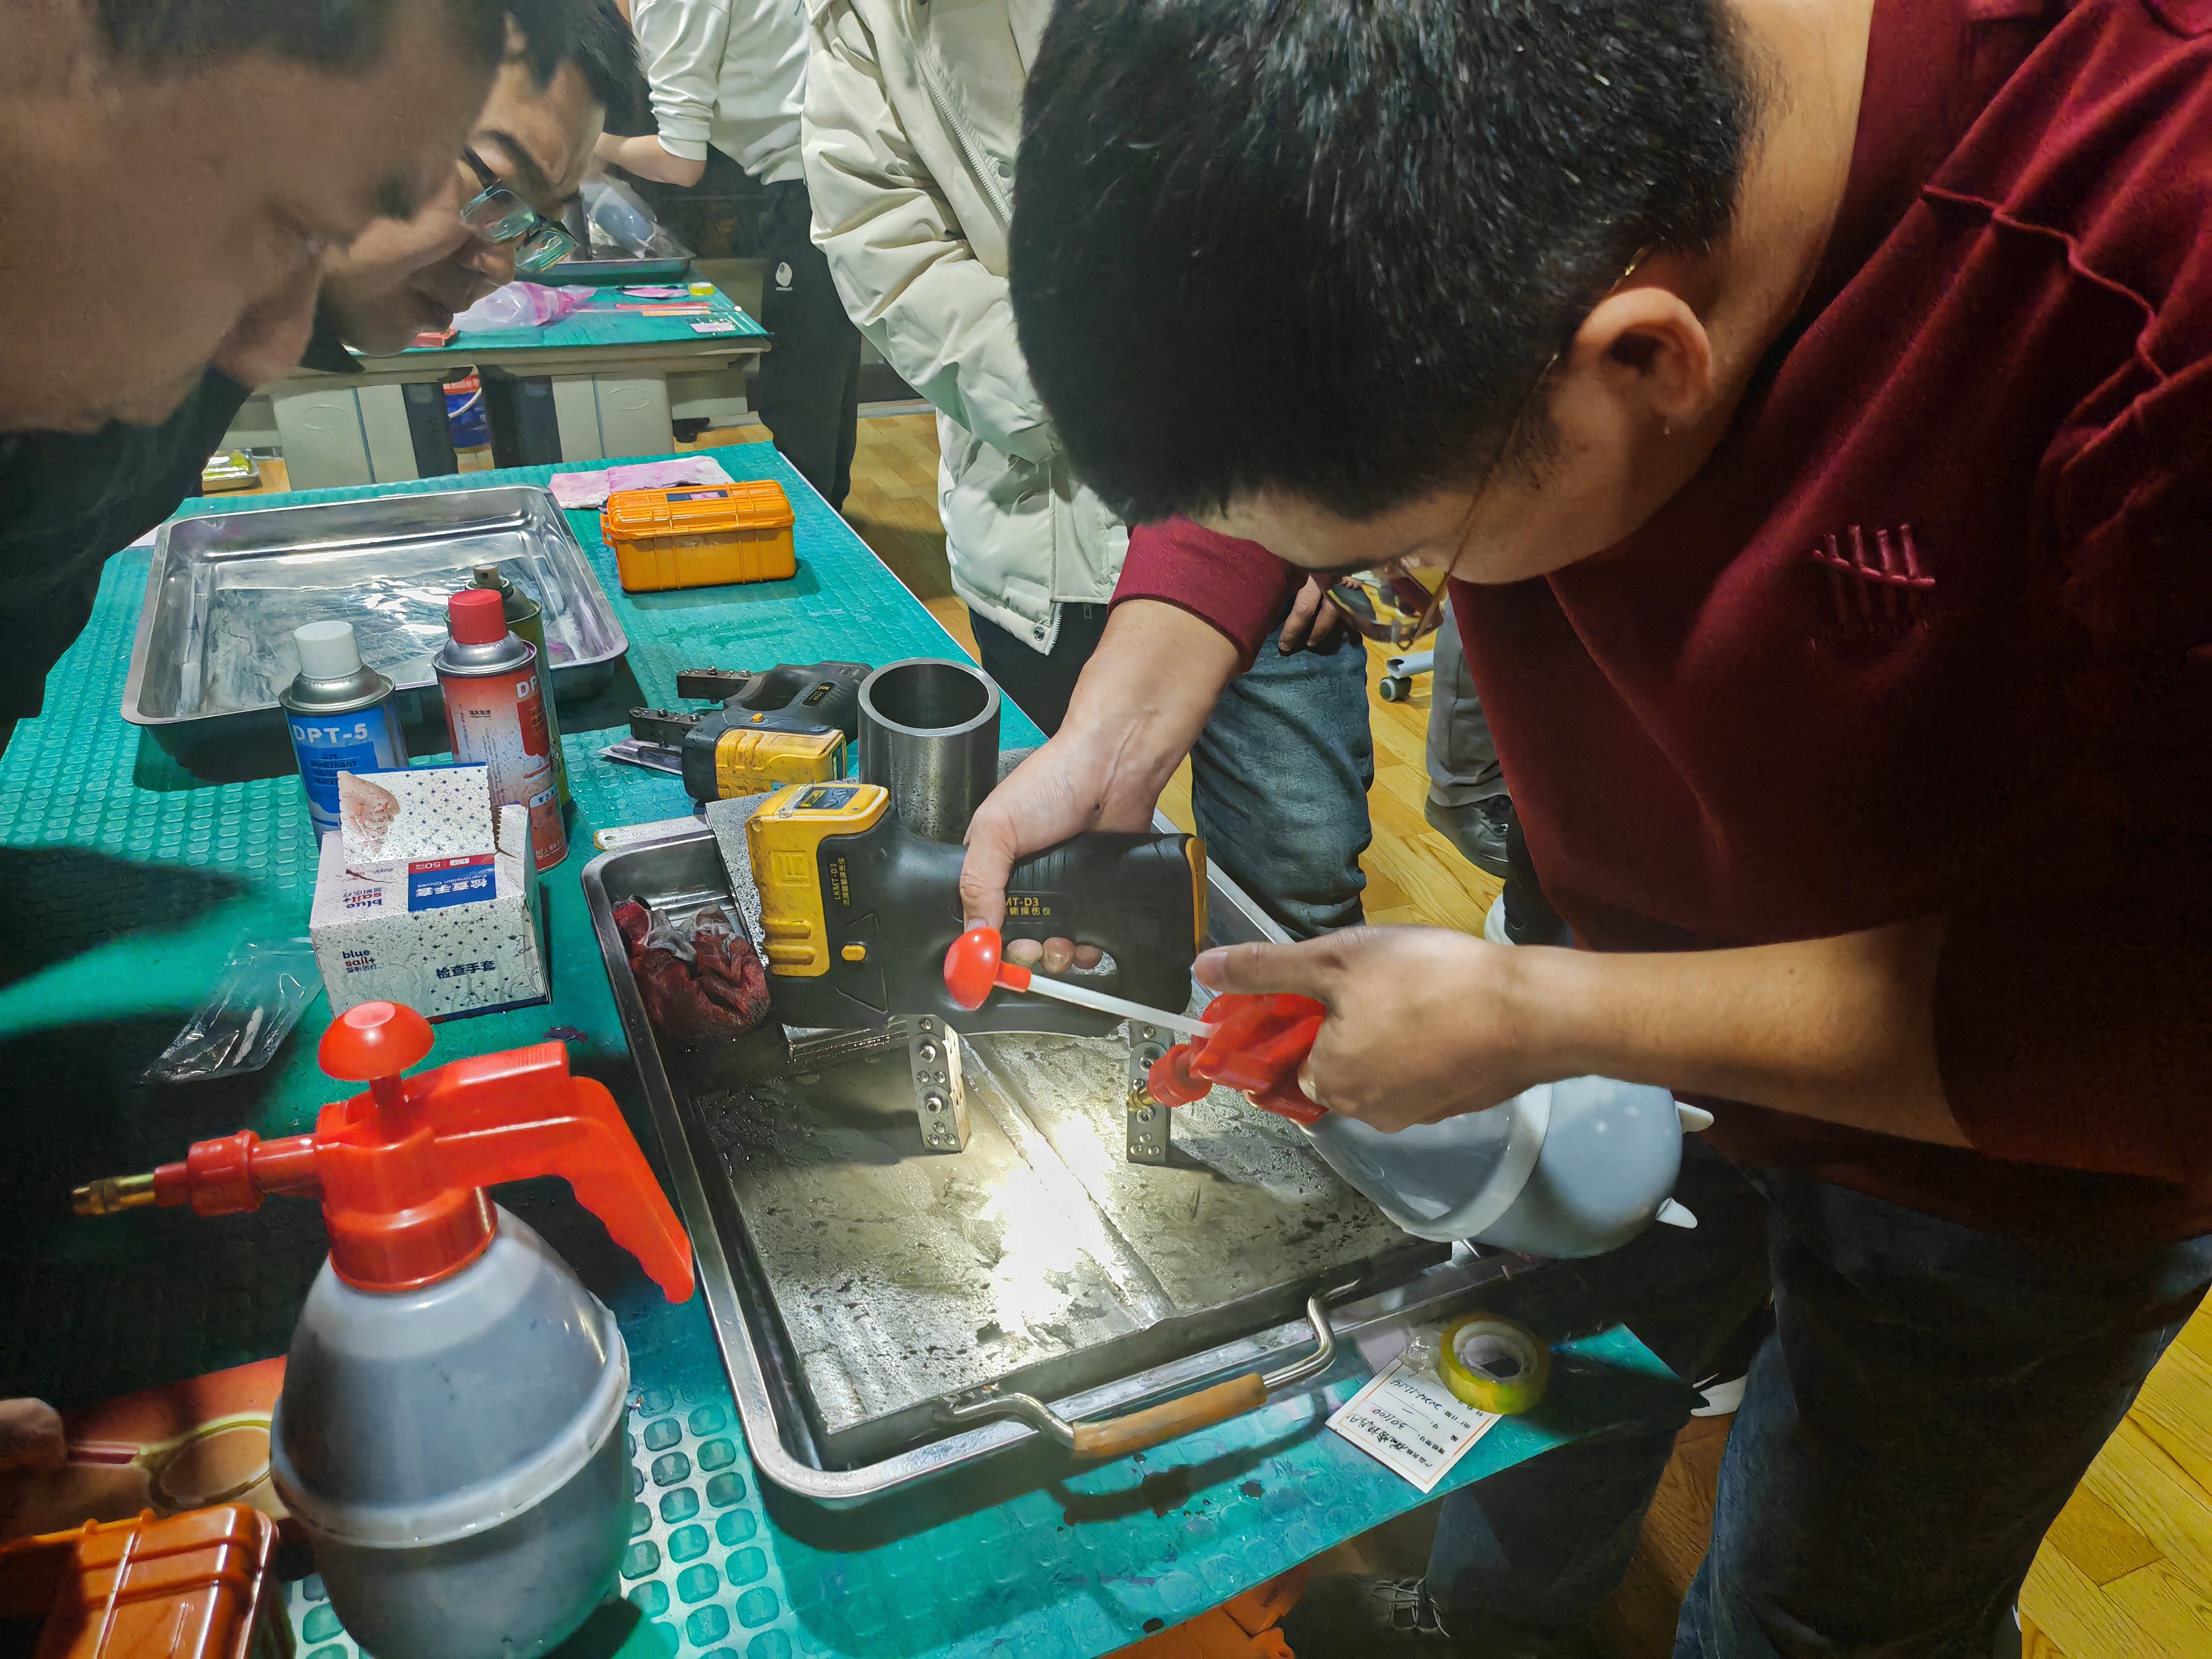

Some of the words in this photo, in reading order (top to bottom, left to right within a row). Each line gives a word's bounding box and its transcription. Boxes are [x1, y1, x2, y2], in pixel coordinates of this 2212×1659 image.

[292, 723, 368, 744] DPT-5
[415, 878, 488, 897] 检查手套
[830, 863, 841, 900] LKMT-D3
[346, 898, 383, 908] blue
[342, 949, 370, 959] blue
[435, 960, 496, 980] 检查手套
